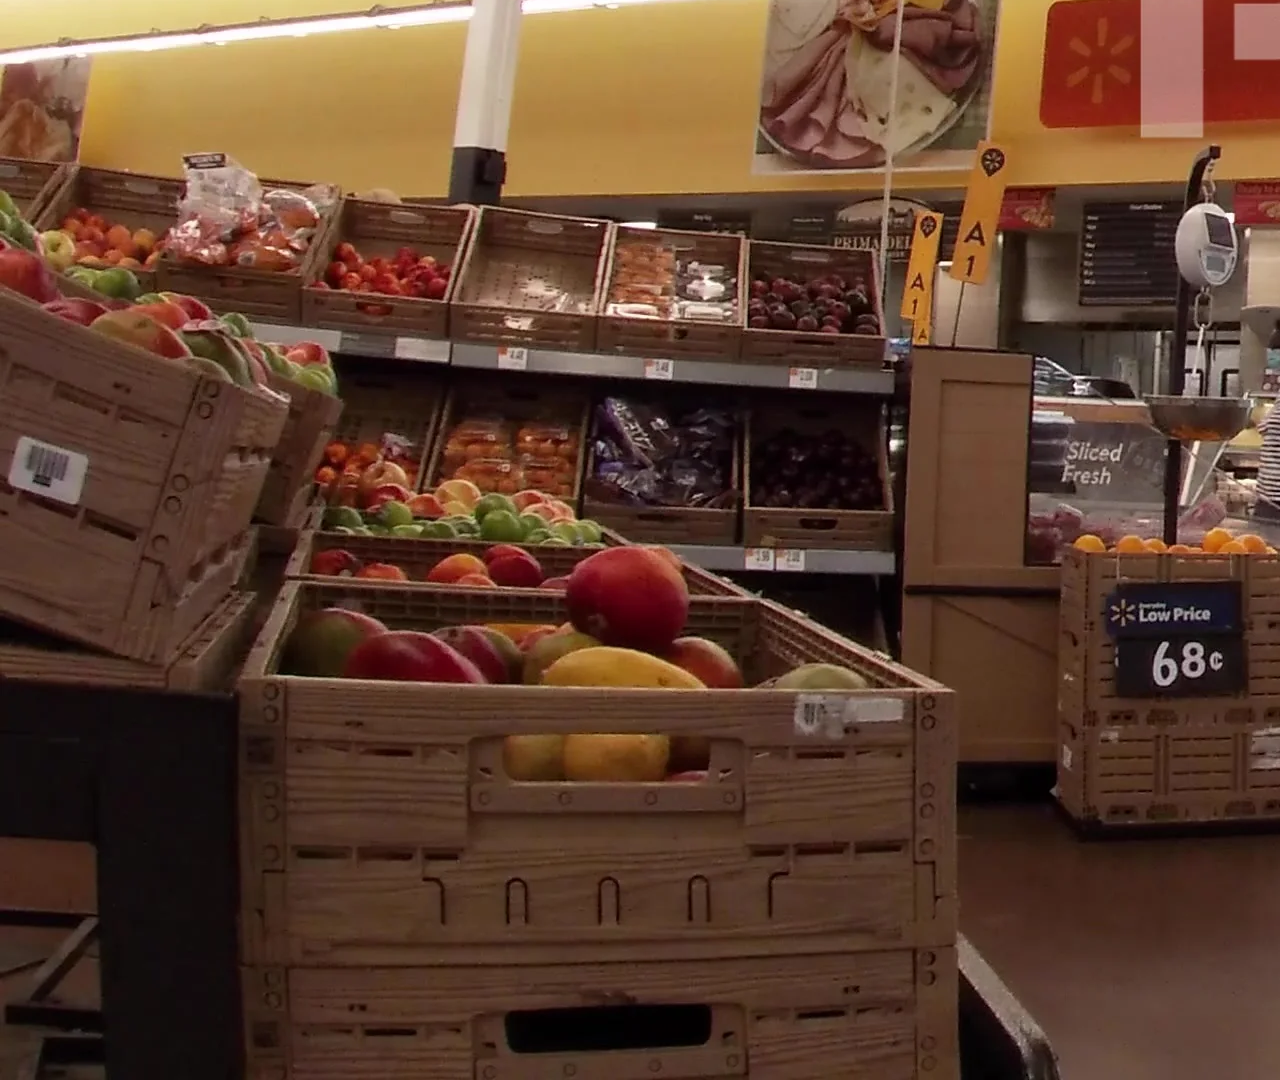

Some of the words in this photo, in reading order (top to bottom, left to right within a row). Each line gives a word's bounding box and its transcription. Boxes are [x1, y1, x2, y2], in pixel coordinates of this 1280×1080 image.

[834, 234, 880, 250] PRIMA
[964, 221, 986, 247] A
[966, 255, 976, 278] 1
[910, 272, 925, 291] A
[911, 298, 919, 315] 1
[918, 328, 928, 341] A
[1066, 441, 1124, 462] Sliced
[1061, 461, 1112, 485] Fresh
[1138, 609, 1171, 623] Low
[1173, 607, 1211, 622] Price
